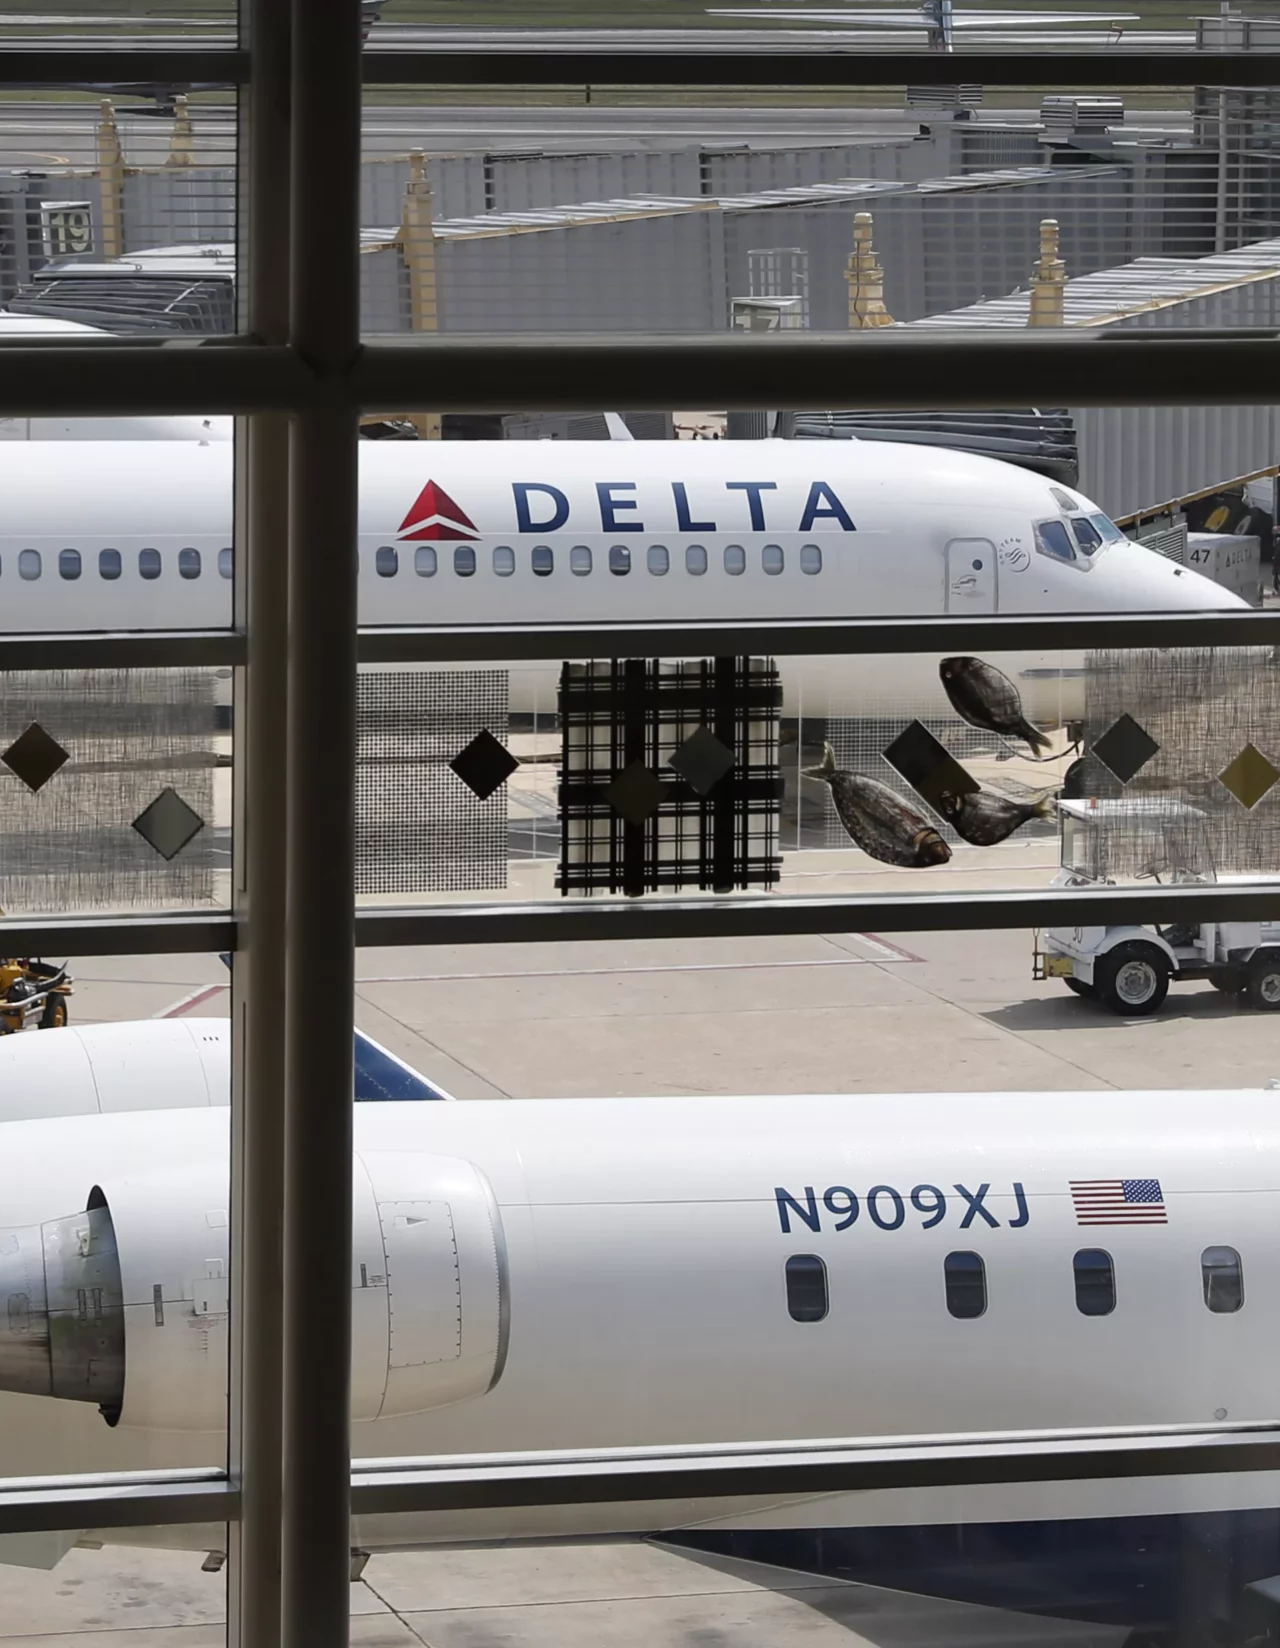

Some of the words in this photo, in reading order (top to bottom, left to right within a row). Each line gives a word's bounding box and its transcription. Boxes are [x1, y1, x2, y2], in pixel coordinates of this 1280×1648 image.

[51, 210, 89, 252] 19
[511, 481, 858, 533] DELTA
[1189, 549, 1211, 564] 47
[773, 1182, 1031, 1234] N909XJ
